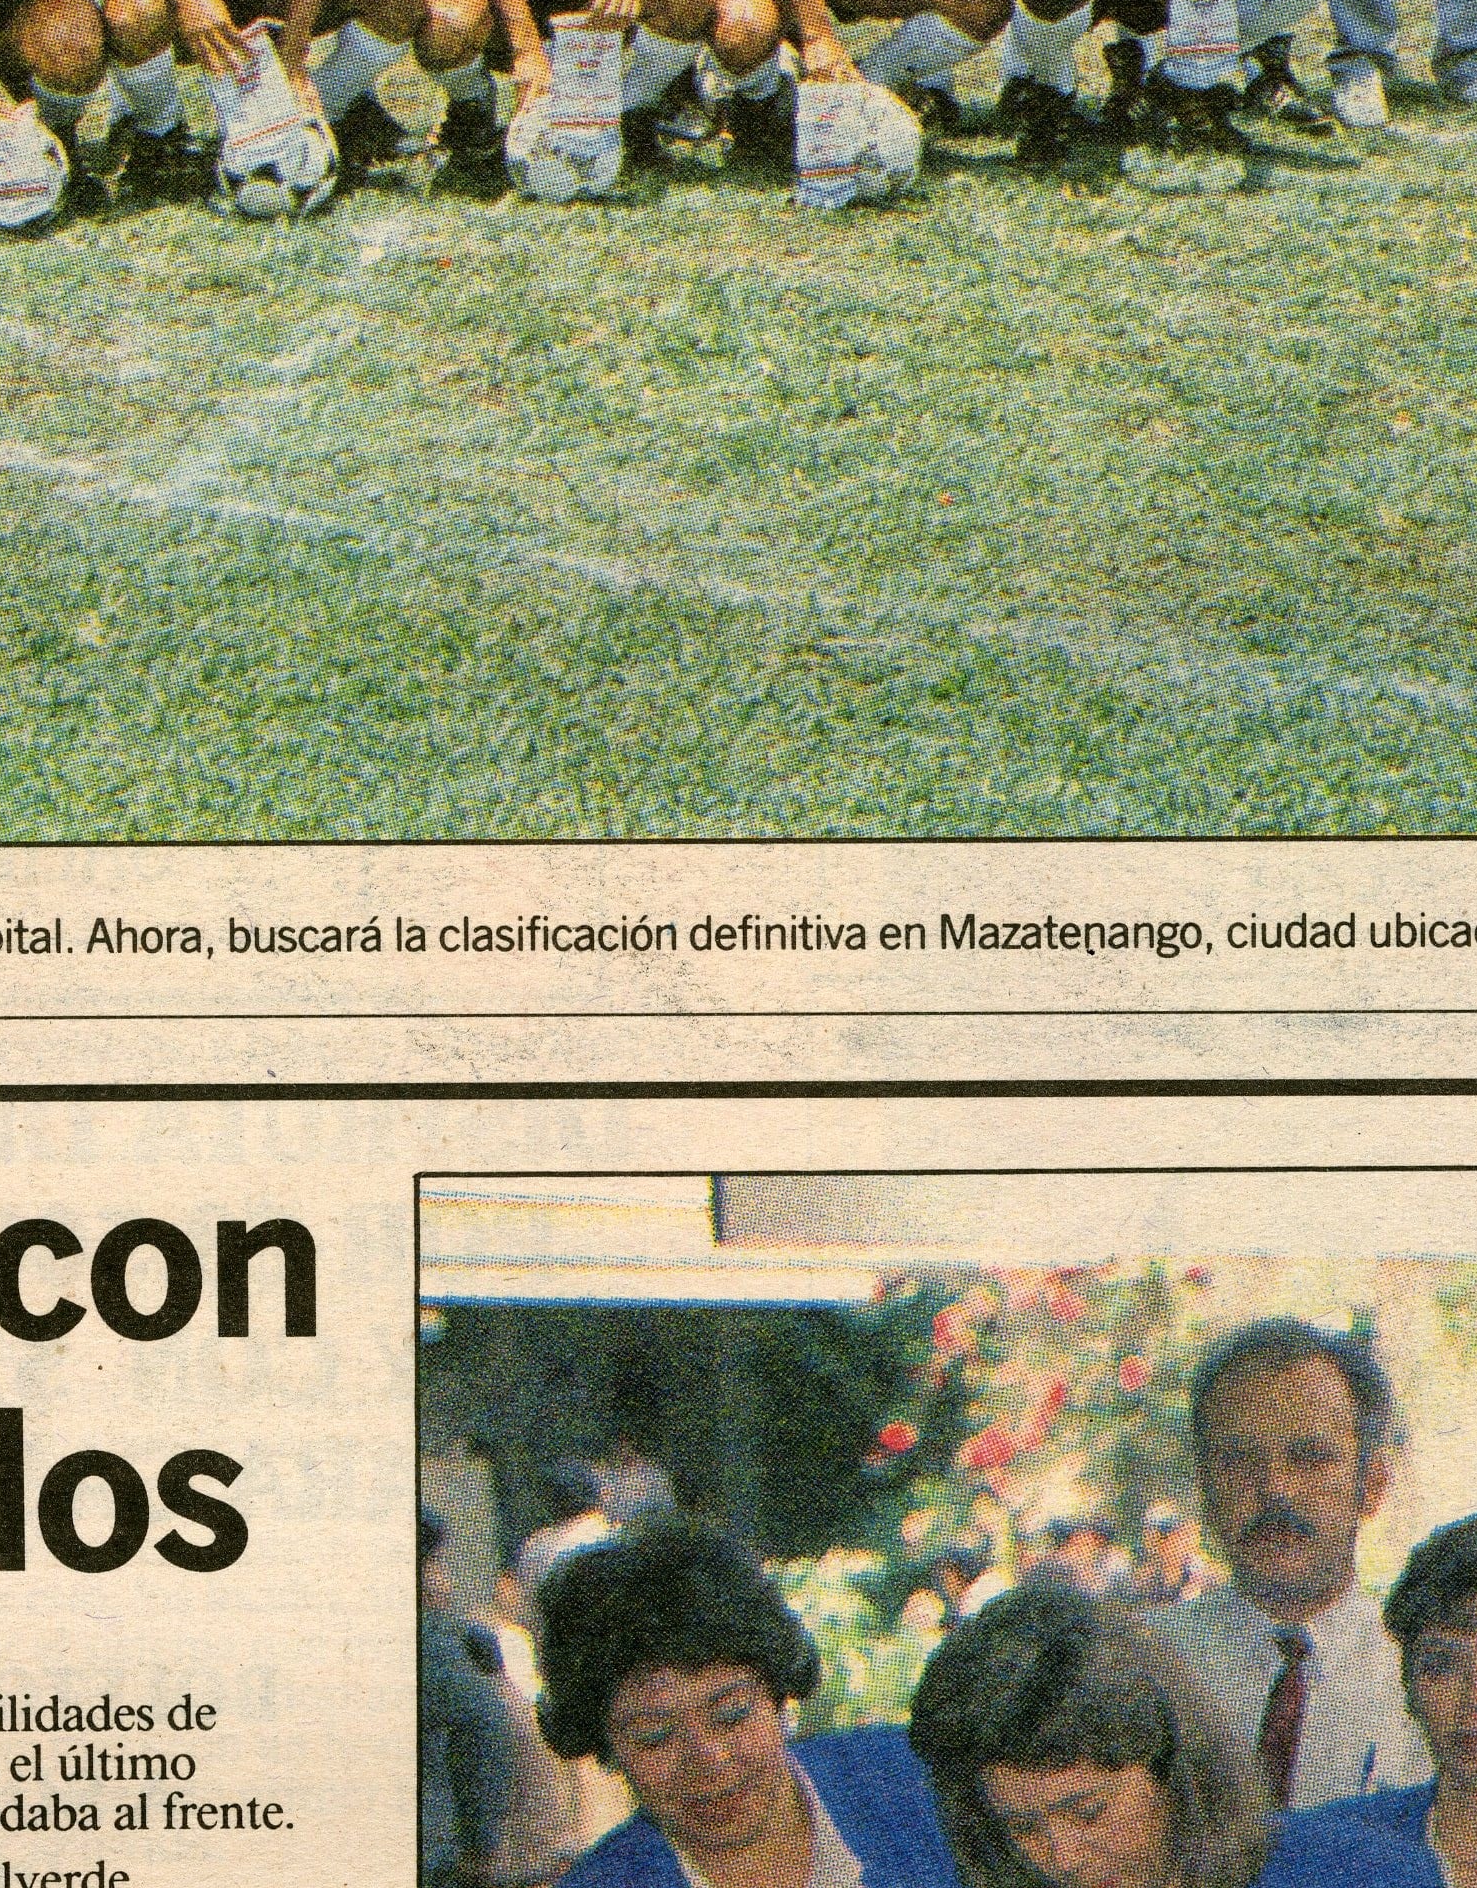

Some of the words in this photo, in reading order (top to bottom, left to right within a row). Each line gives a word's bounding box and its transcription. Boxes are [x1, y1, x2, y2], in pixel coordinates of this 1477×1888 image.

[87, 918, 213, 959] Ahora,
[230, 916, 381, 953] buscará
[397, 917, 426, 952] la
[440, 915, 676, 952] clasificación
[690, 915, 865, 951] definitiva
[880, 924, 925, 950] en
[941, 914, 1212, 958] Mazatenango,
[1228, 913, 1355, 948] ciudad
